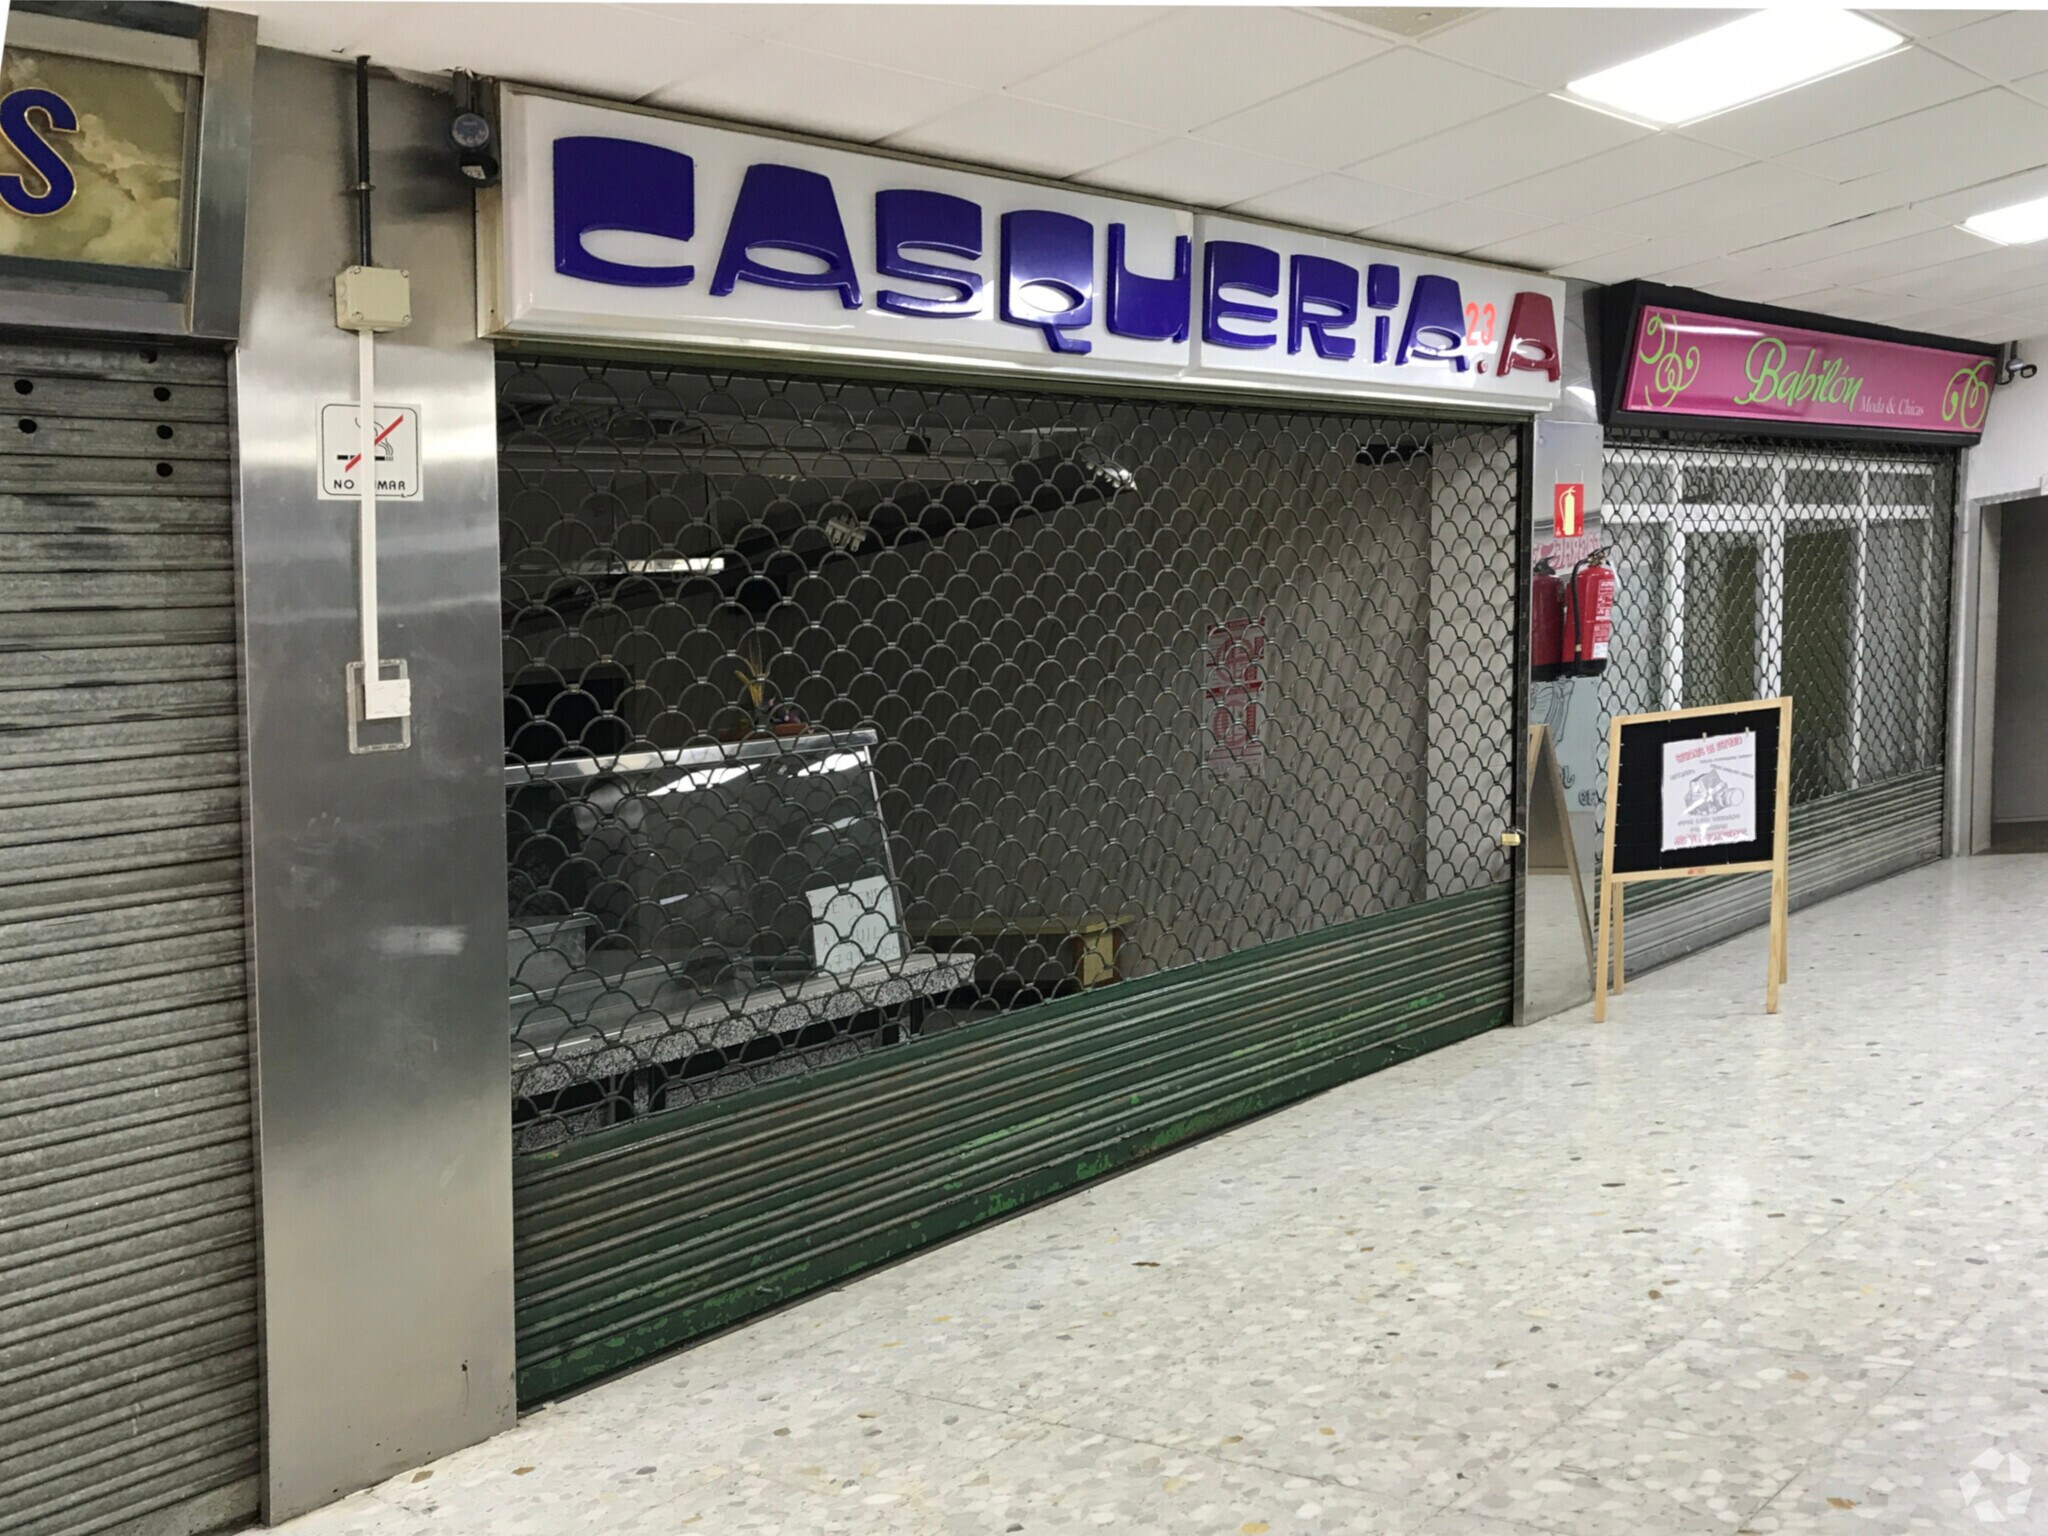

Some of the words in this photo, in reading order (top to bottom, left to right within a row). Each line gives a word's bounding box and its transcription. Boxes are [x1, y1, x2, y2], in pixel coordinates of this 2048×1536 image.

[0, 87, 79, 217] S
[1465, 301, 1496, 347] 23
[1734, 337, 1864, 412] Babilón
[1859, 395, 1885, 413] Moda
[1886, 396, 1897, 414] &
[1898, 397, 1925, 416] Chicas
[333, 479, 355, 490] NO
